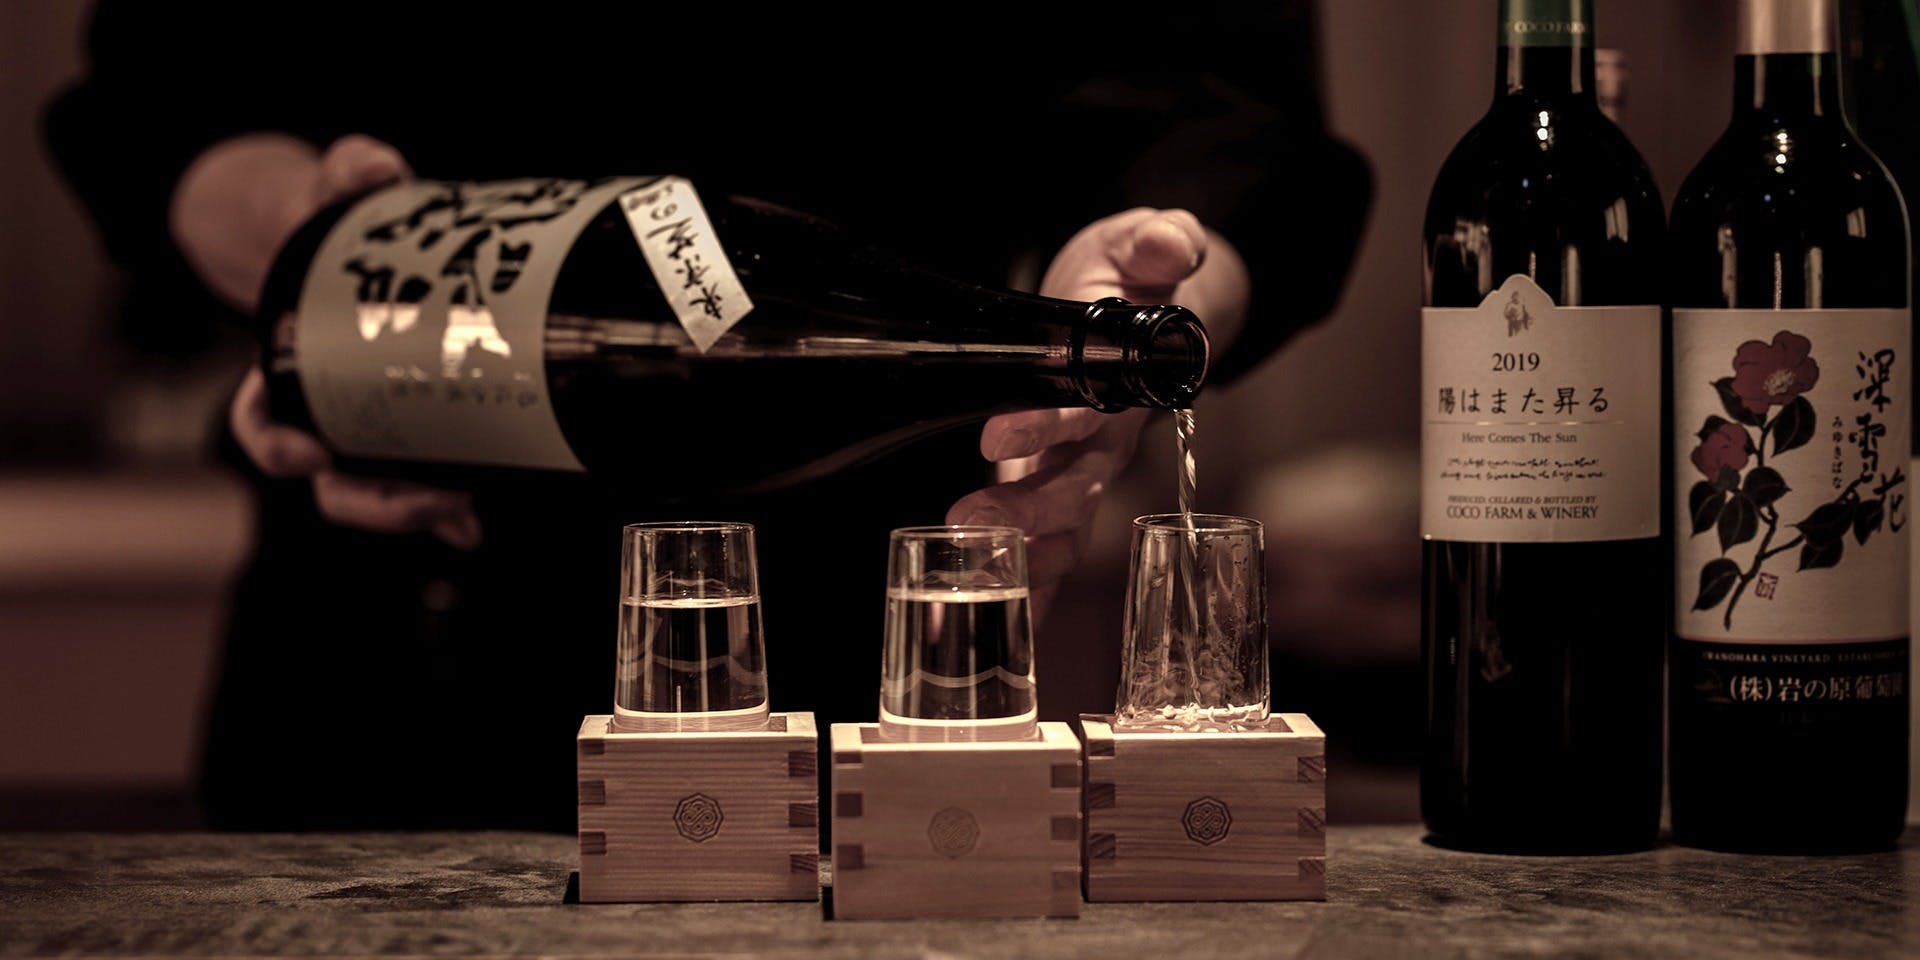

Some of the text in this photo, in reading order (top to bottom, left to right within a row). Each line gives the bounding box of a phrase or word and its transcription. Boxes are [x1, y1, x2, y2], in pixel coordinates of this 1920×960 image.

[1491, 352, 1540, 372] 2019
[1437, 386, 1609, 415] 陽はまた昇る
[1461, 432, 1578, 444] Here Comes The Sun
[1446, 505, 1599, 520] COCO FARM & WINERY
